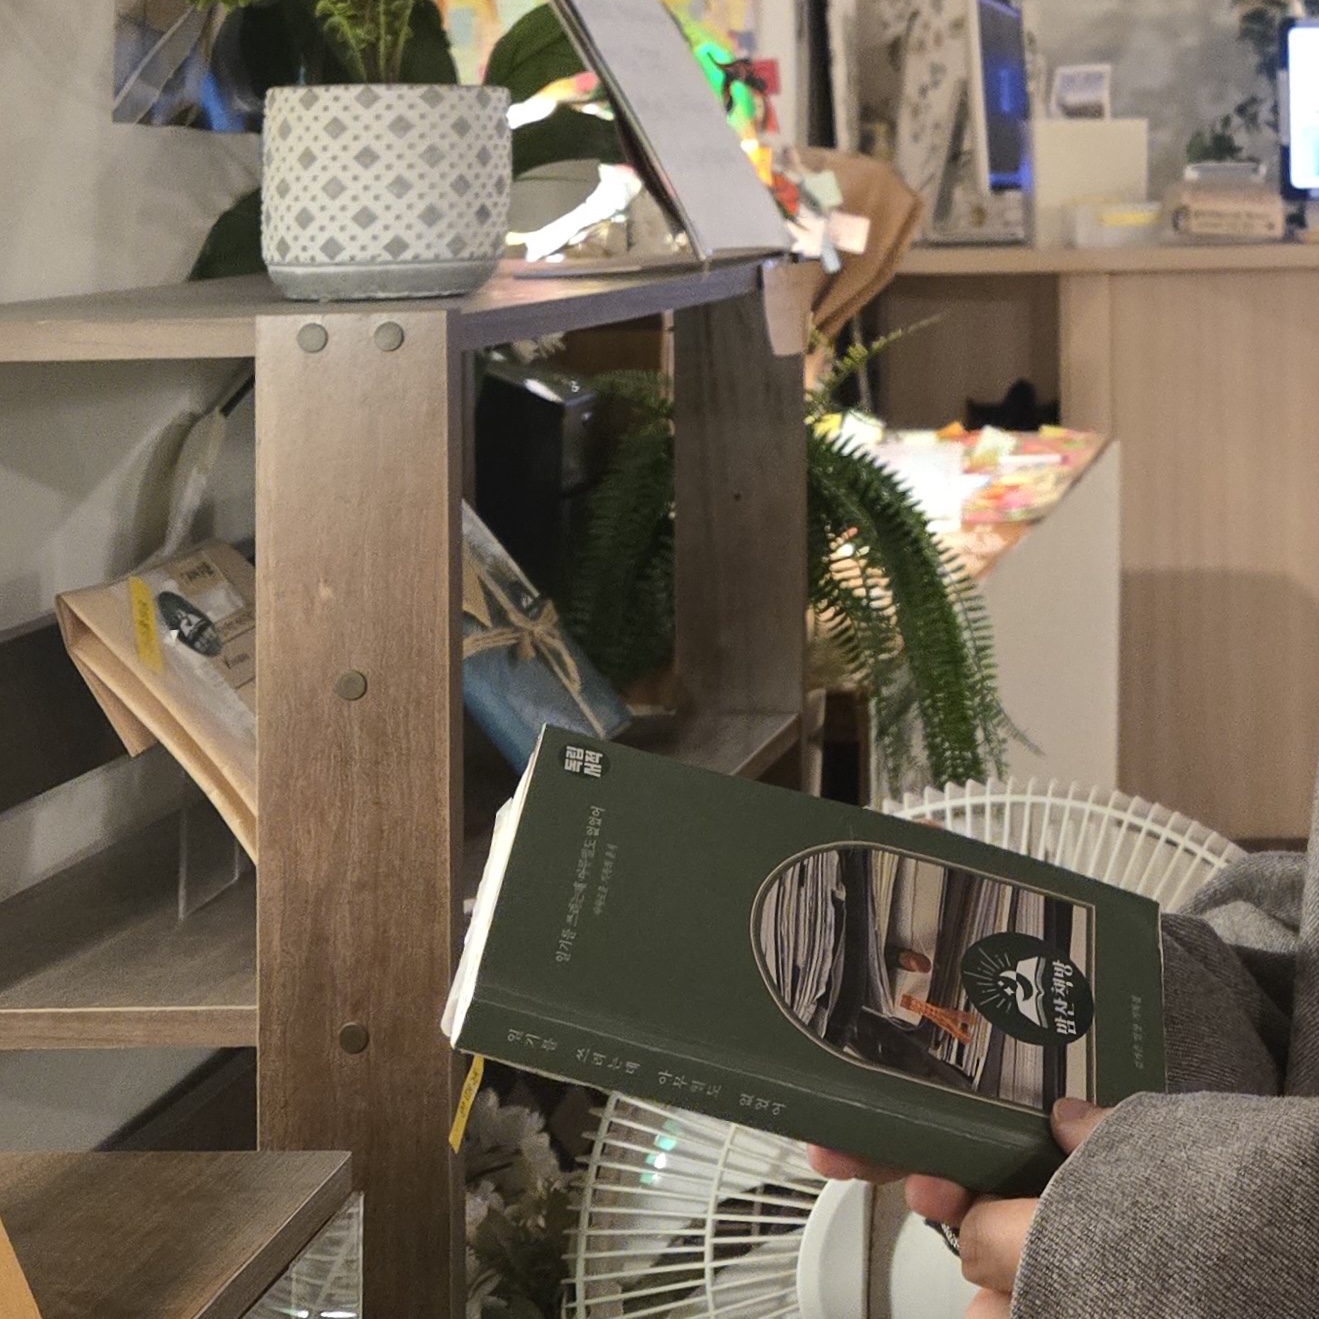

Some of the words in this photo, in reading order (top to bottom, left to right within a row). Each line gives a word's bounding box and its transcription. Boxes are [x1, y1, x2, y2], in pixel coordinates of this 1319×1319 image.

[564, 745, 584, 773] 독립
[583, 749, 603, 778] 서적
[1051, 959, 1077, 1035] 밤산책방
[507, 1029, 558, 1051] 일기를
